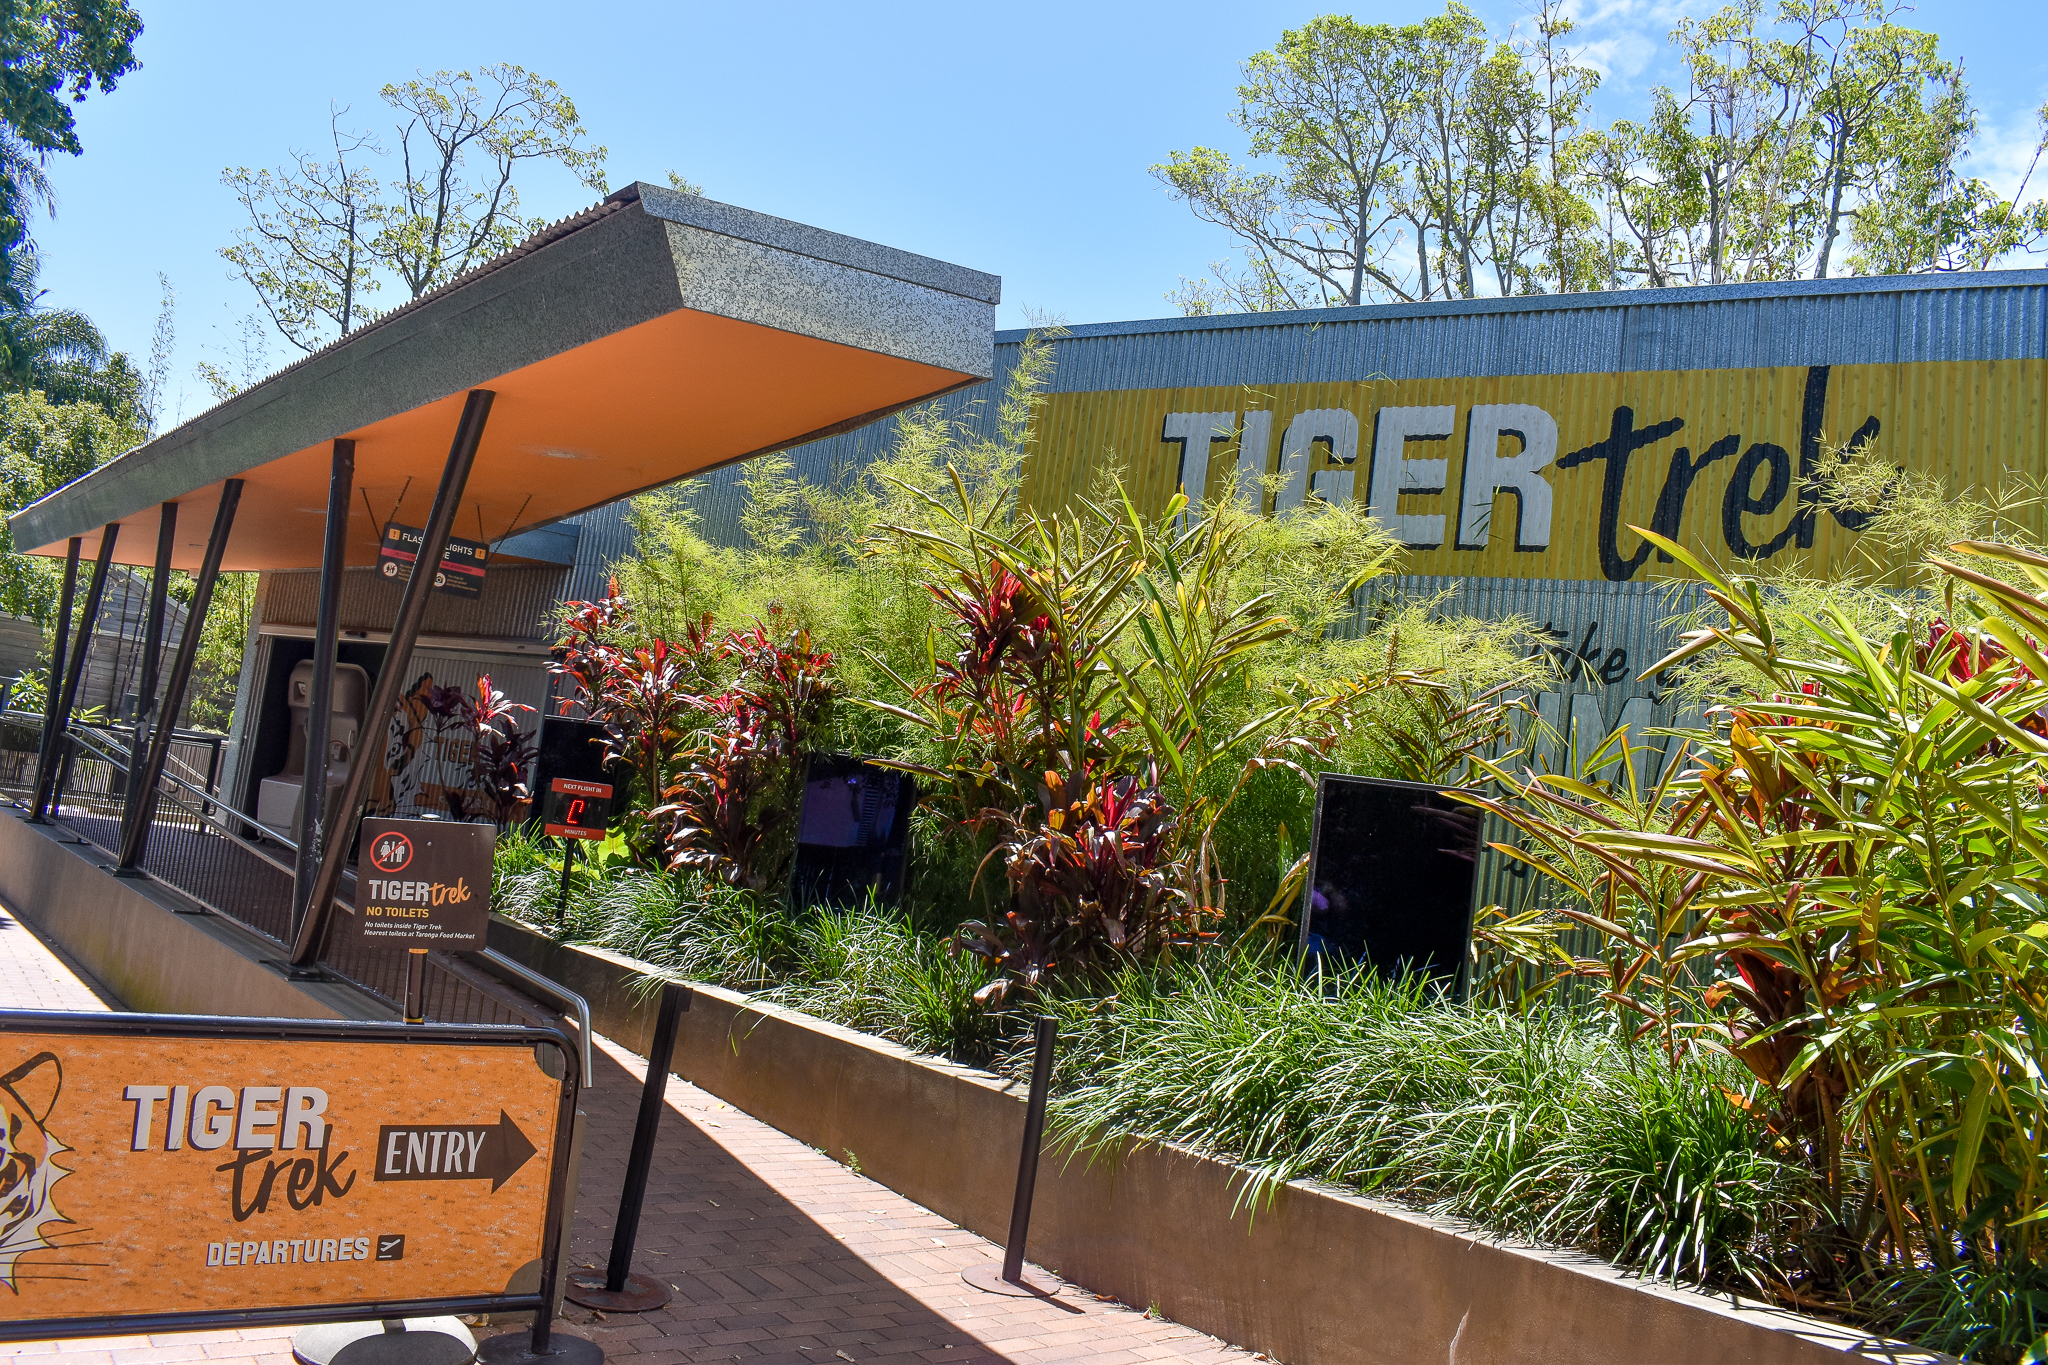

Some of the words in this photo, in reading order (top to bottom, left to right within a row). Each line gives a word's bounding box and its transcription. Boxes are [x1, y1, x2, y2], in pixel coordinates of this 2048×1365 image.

[1161, 403, 1558, 553] TIGER
[1557, 365, 1906, 581] trek
[402, 533, 424, 544] FLAS
[577, 785, 595, 793] FLIGHT
[368, 879, 430, 902] TIGER
[428, 877, 471, 907] trek
[366, 906, 383, 916] NO
[385, 907, 430, 918] TOILETS
[413, 923, 428, 931] Tiger
[415, 931, 439, 939] Taronga
[122, 1085, 329, 1151] TIGER
[384, 1131, 486, 1175] ENTRY
[215, 1124, 357, 1222] trek
[206, 1237, 370, 1267] DEPARTURES
